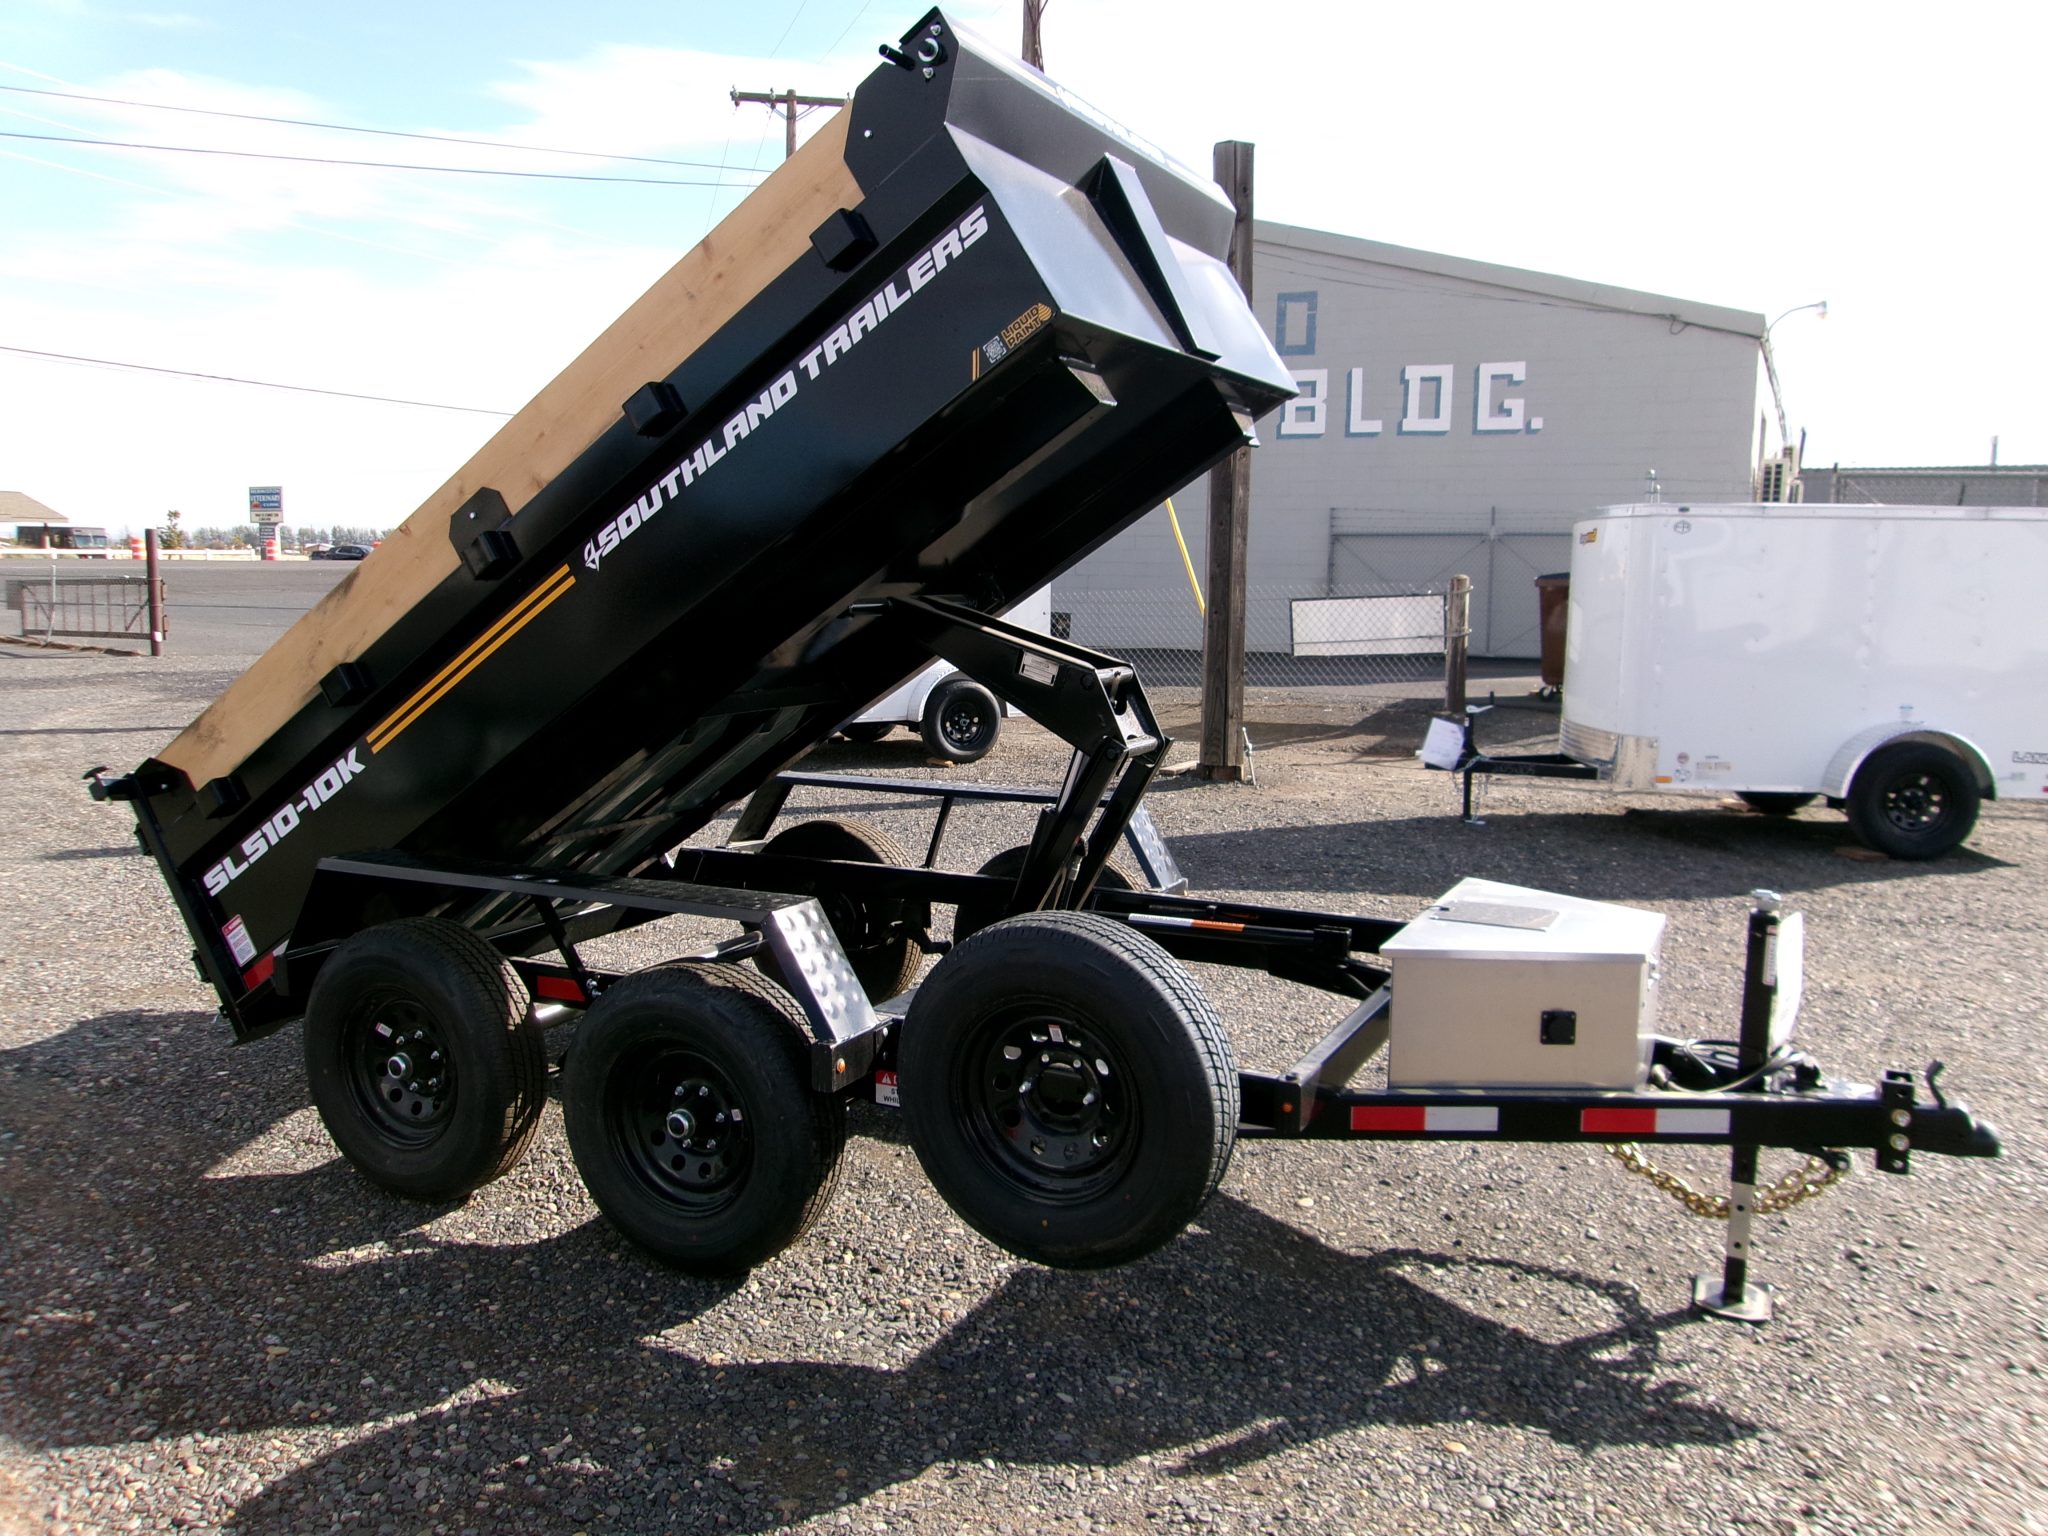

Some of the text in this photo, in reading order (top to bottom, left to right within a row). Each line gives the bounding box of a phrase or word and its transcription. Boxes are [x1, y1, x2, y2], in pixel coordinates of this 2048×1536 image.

[1001, 305, 1040, 340] LIQUID
[1006, 318, 1041, 349] PAINT
[599, 205, 989, 558] SOUTHLAND TRAILERS
[1277, 361, 1543, 440] BLDG.
[203, 747, 367, 897] SLS10-10K
